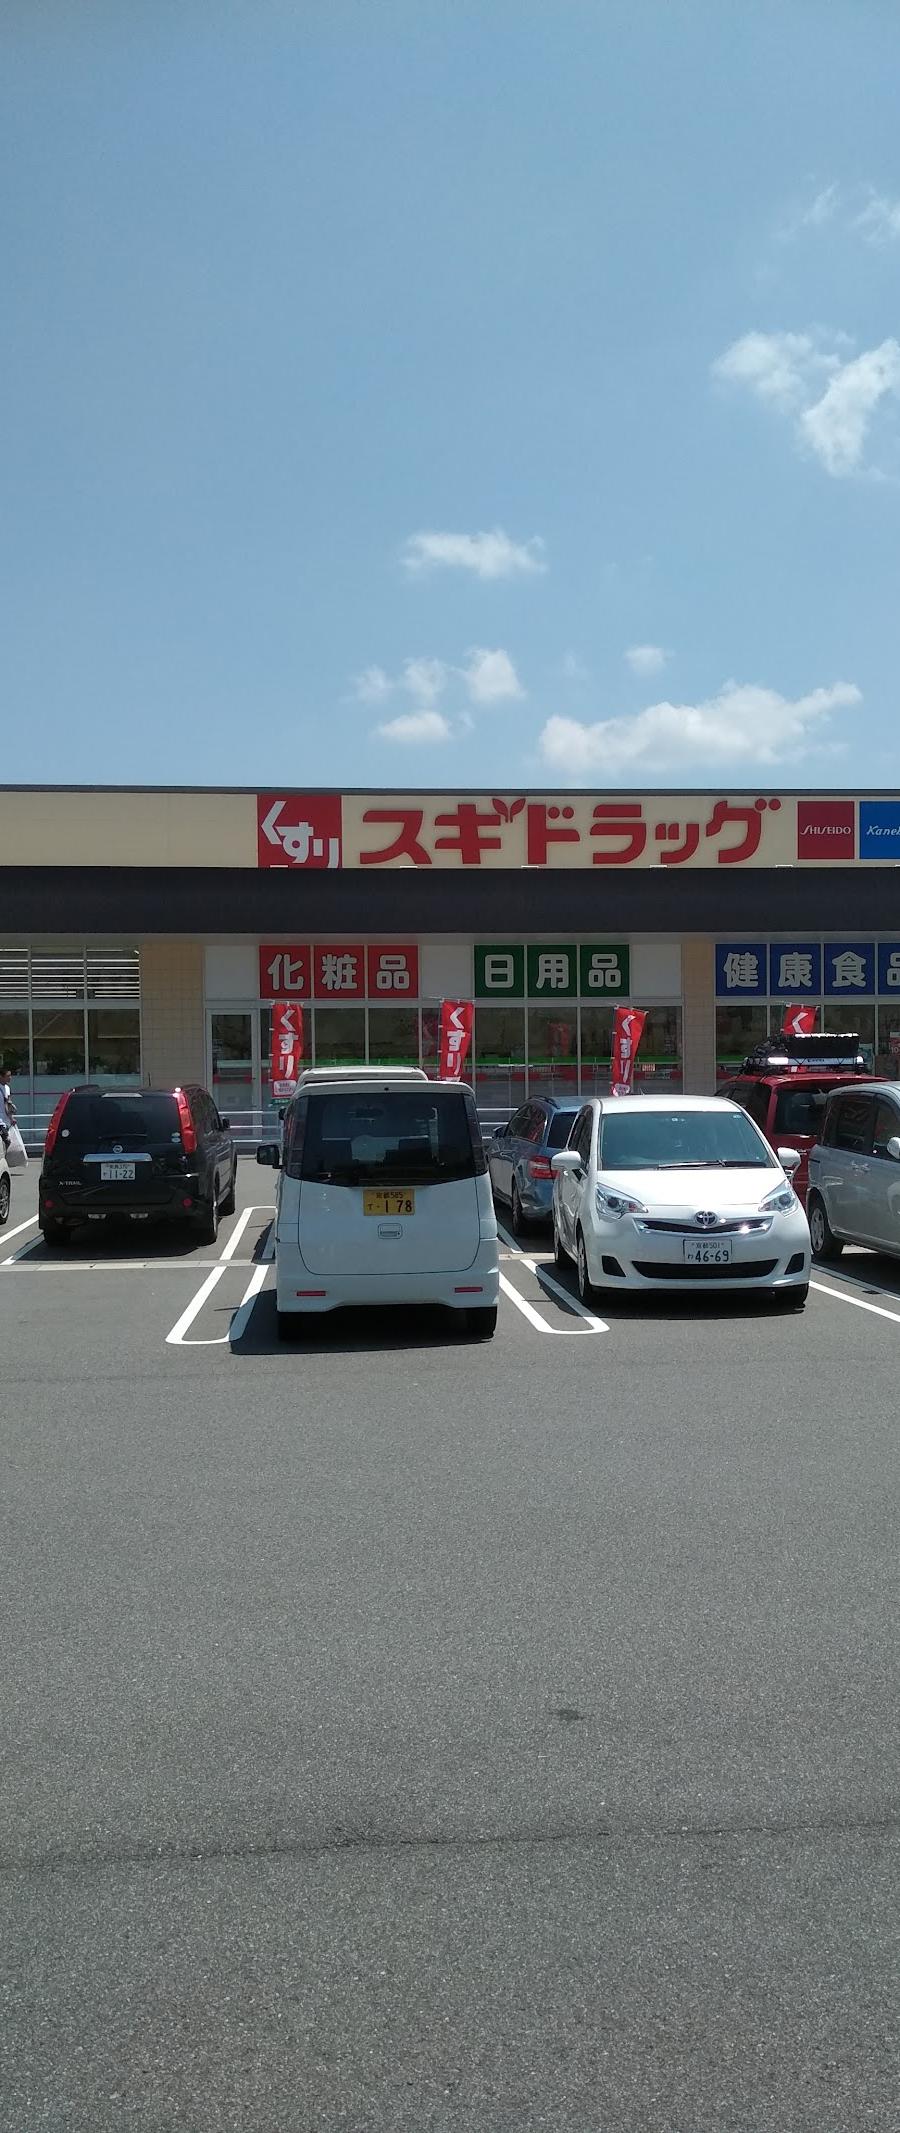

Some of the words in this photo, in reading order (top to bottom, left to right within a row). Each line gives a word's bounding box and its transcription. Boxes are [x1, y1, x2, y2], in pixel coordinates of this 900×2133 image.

[261, 801, 339, 868] くすり
[360, 798, 781, 864] スギドラッグ
[800, 825, 851, 835] SHISEIDO
[267, 954, 410, 990] 化粧品
[484, 953, 622, 989] 日用品
[278, 1009, 299, 1079] くすり
[447, 1007, 466, 1075] くすり
[620, 1015, 637, 1083] くすり
[110, 1170, 134, 1178] 11-22
[695, 1250, 729, 1262] 46-69
